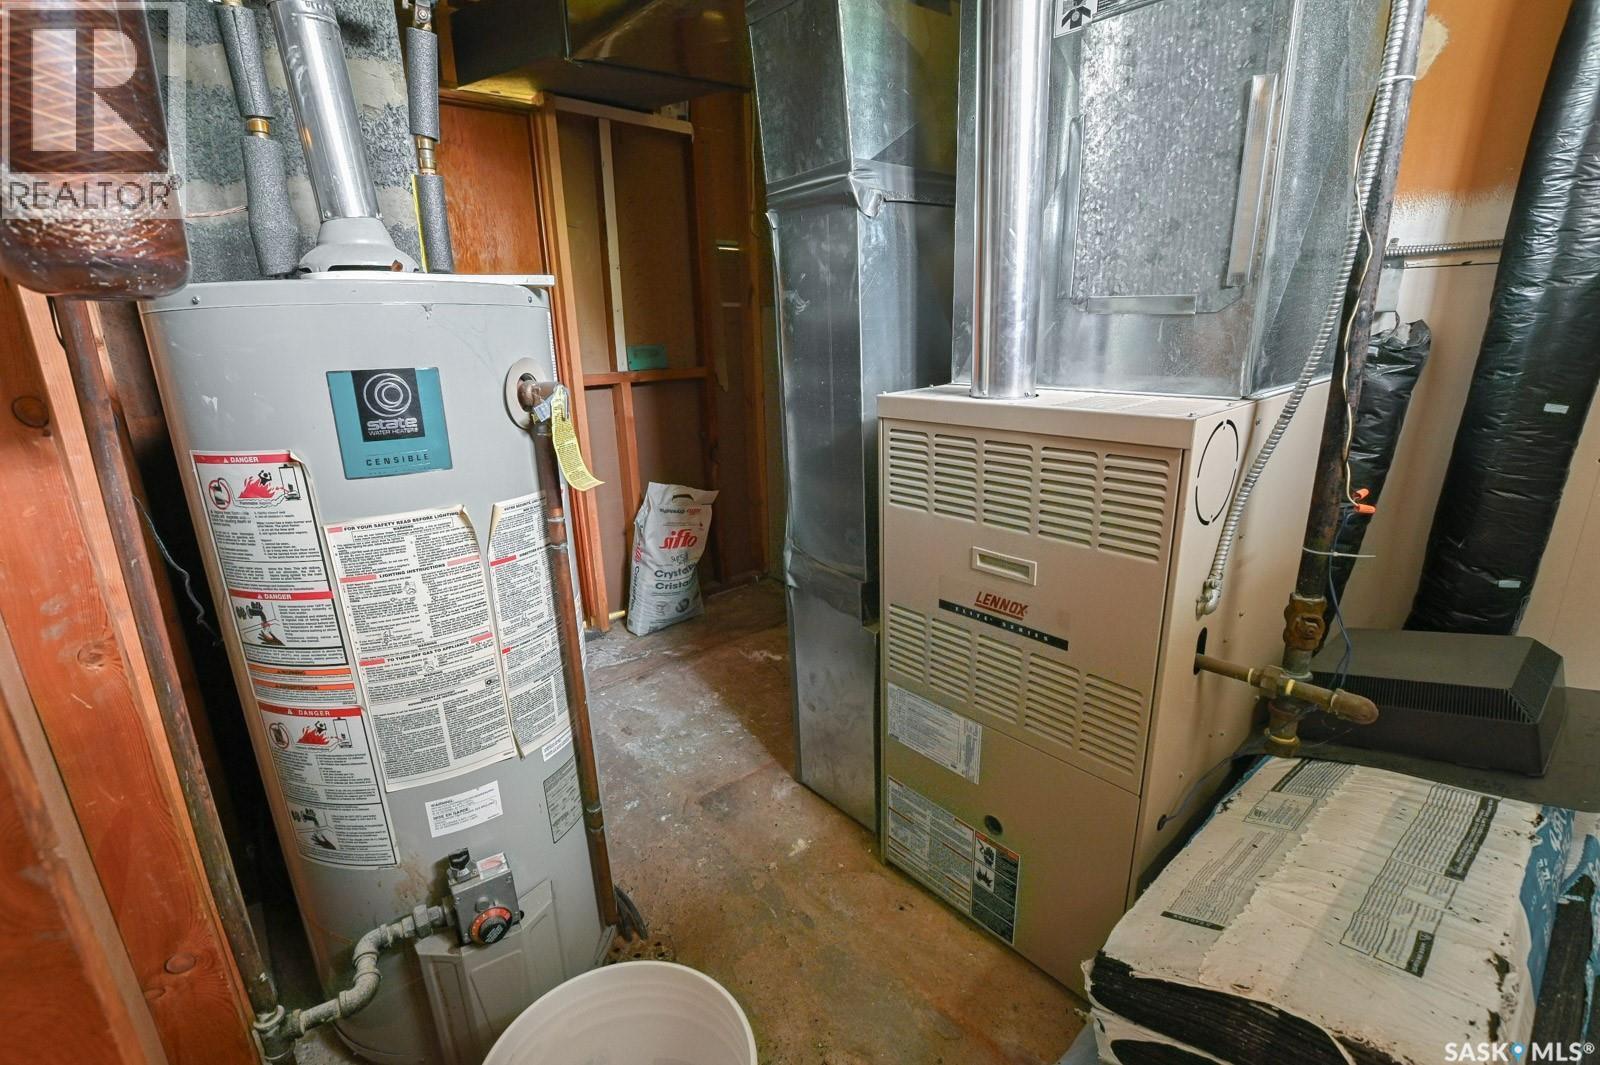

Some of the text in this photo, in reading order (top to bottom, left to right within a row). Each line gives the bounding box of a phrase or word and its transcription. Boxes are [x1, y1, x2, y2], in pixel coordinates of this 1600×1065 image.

[366, 417, 418, 431] state
[230, 456, 259, 464] DANGER
[366, 453, 430, 467] CENSIBLE
[373, 521, 395, 529] SAFETY
[412, 515, 434, 523] BEFORE
[434, 511, 460, 520] LIGHTING
[658, 528, 698, 550] sifto
[379, 563, 446, 579] LIGHTING INSTRUCTIONS
[975, 591, 1029, 617] LENNOX
[442, 641, 470, 652] APPLIANCE
